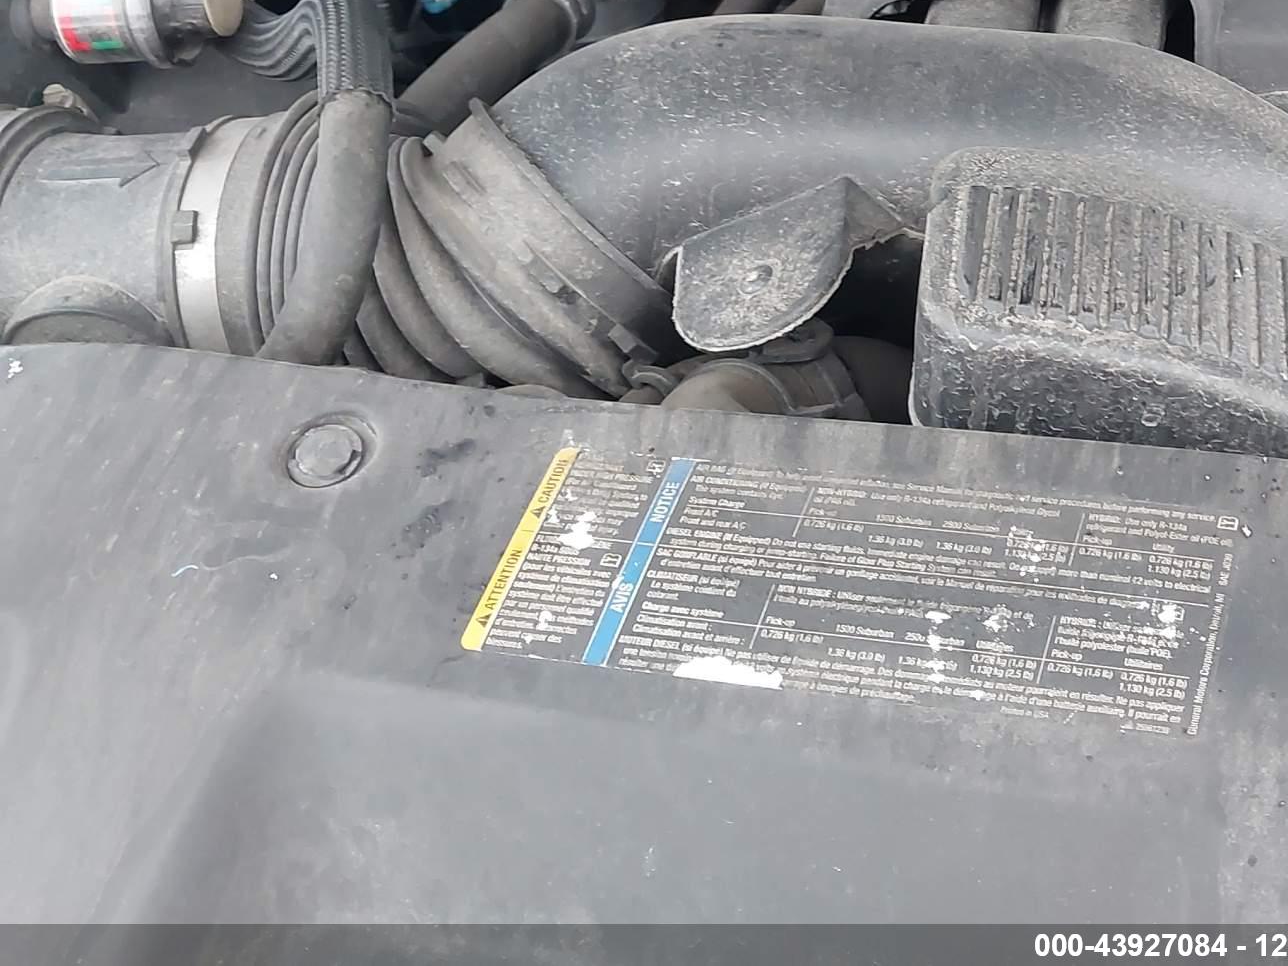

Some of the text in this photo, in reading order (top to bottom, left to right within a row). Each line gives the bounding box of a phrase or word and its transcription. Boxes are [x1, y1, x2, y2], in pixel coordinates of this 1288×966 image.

[538, 459, 568, 503] CAUTION
[650, 481, 680, 523] NOTICE
[687, 495, 746, 508] System Charge
[485, 549, 522, 609] ATTENTION
[610, 581, 635, 613] AVIS
[1200, 631, 1218, 676] Corporation,
[1193, 674, 1208, 705] Motors
